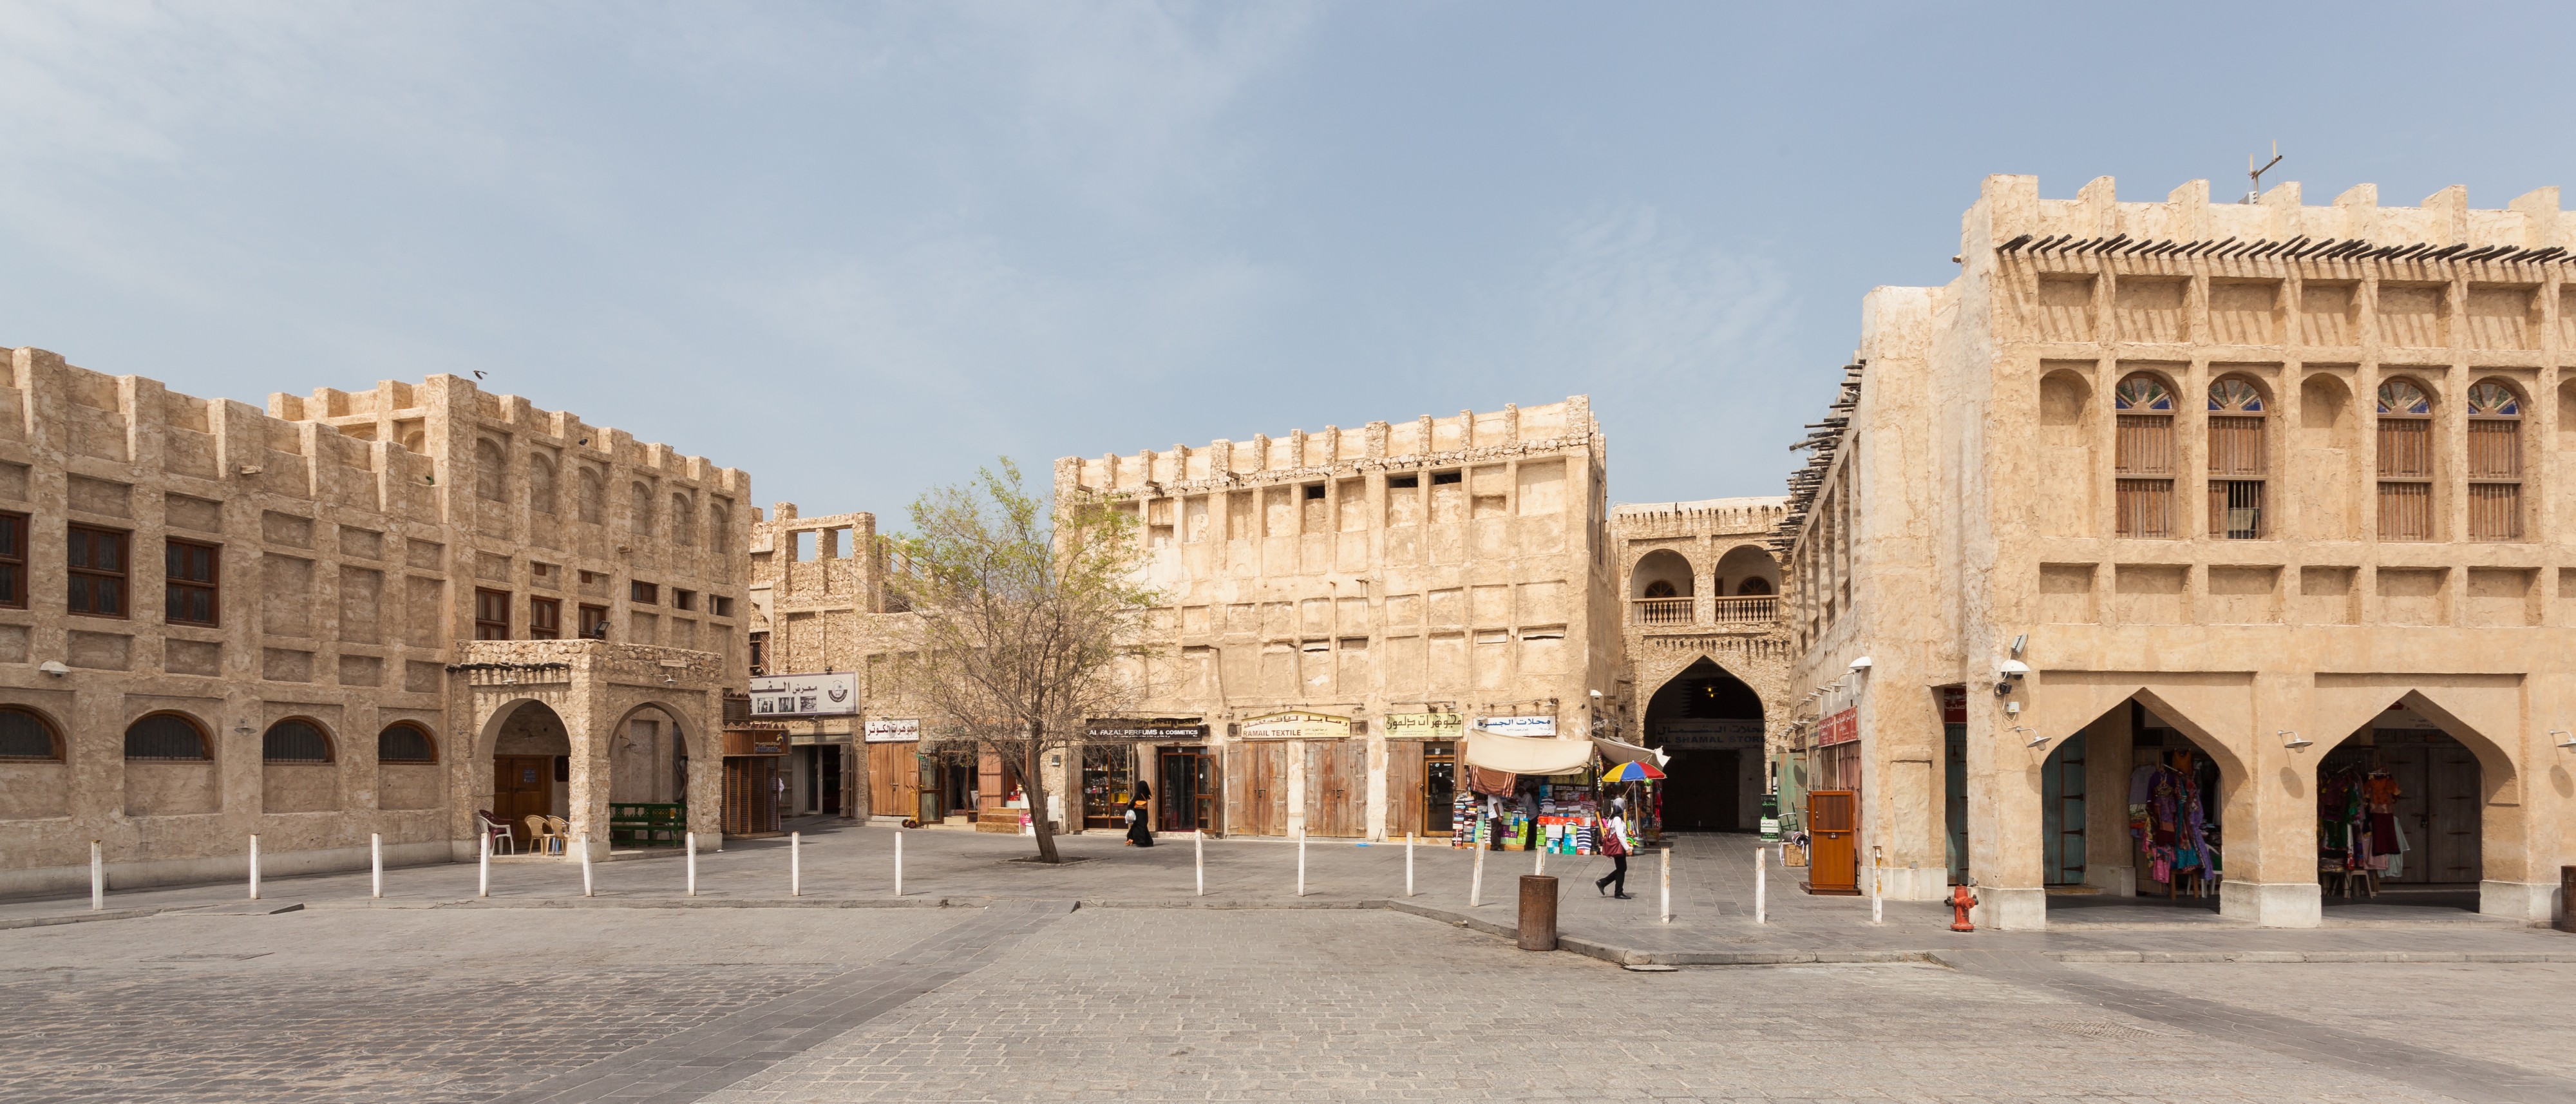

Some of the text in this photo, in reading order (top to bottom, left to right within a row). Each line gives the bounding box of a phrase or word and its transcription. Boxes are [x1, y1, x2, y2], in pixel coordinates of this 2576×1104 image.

[792, 683, 818, 694] معرض
[1418, 714, 1462, 728] مجوهرات
[1478, 718, 1513, 728] الجسرة
[867, 722, 891, 736] الكوثر
[1657, 724, 1726, 736] الشمال
